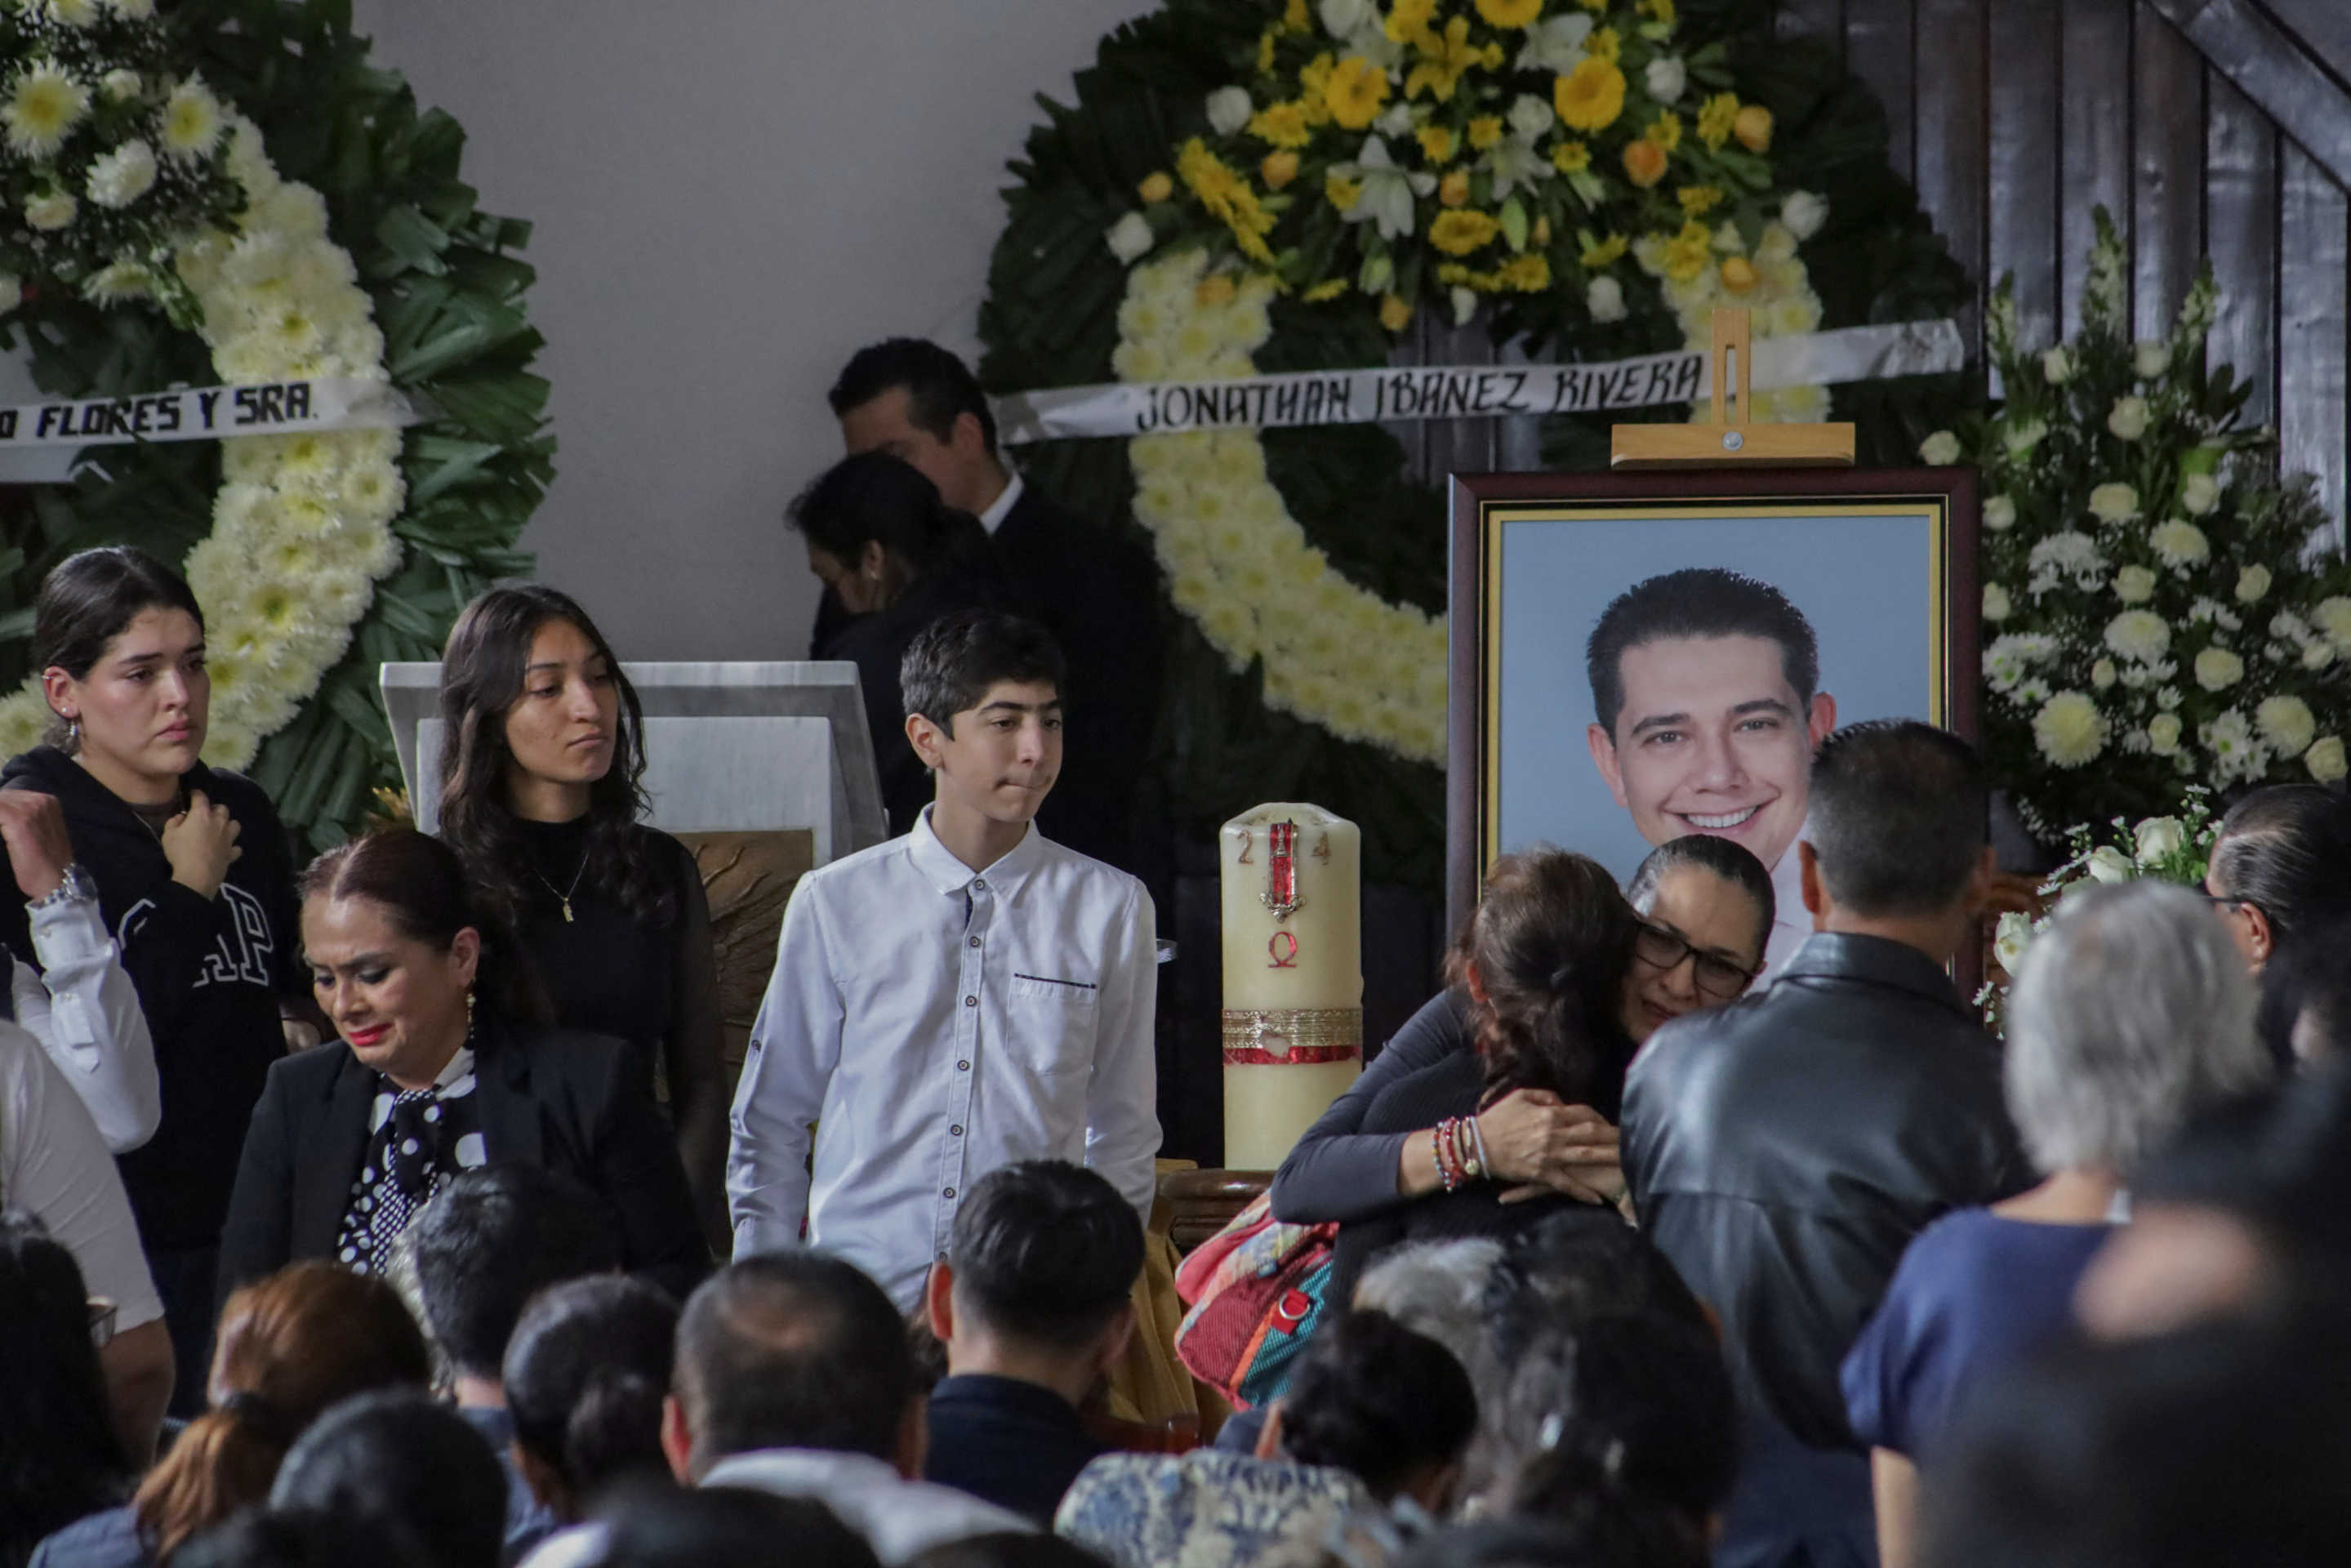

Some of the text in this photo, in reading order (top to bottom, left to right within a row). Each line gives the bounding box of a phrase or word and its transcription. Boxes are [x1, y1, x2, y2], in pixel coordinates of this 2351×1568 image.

[36, 395, 181, 439] FLORES
[198, 390, 222, 429] Y
[234, 383, 319, 425] SRA.
[1136, 376, 1351, 432] JONATHAN
[1553, 354, 1703, 412] RIVERA
